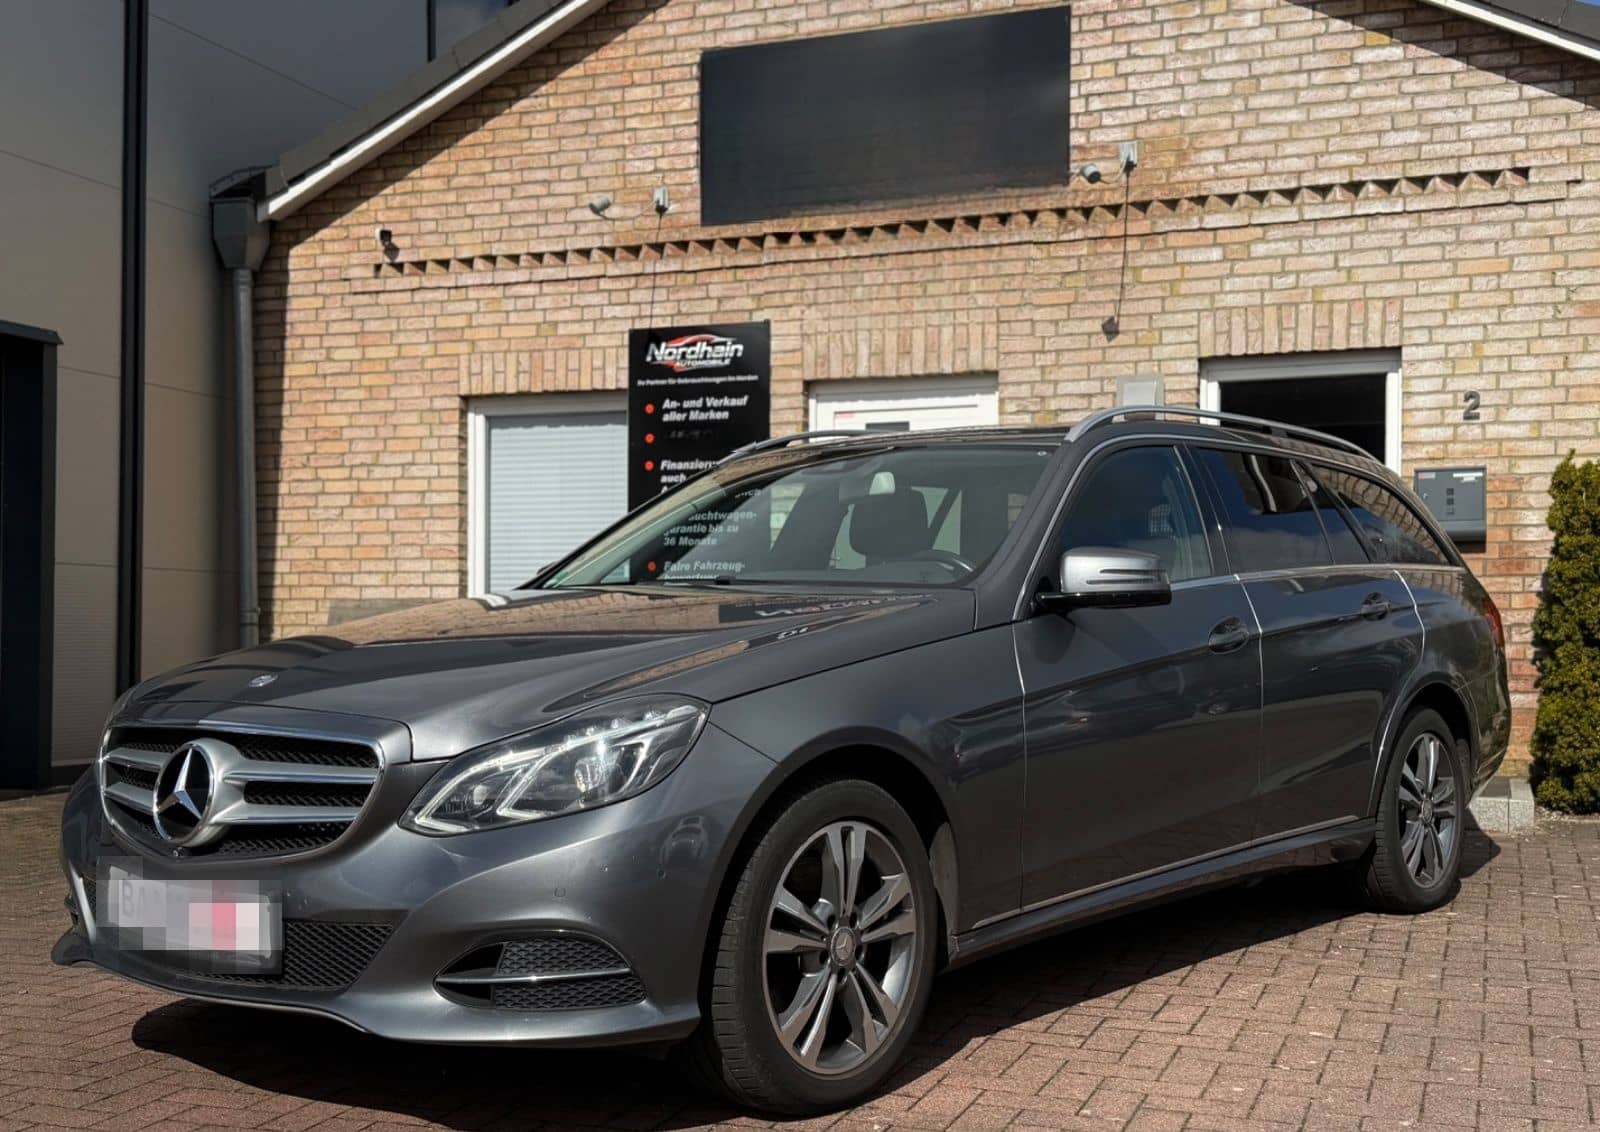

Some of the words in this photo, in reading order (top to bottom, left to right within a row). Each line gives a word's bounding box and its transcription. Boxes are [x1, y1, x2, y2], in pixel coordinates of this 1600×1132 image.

[646, 341, 744, 362] Nordhain
[662, 398, 681, 410] An-
[682, 397, 703, 409] und
[705, 394, 749, 407] Verkauf
[1463, 391, 1480, 420] 2
[662, 411, 687, 422] aller
[689, 410, 729, 421] Marken
[660, 472, 686, 483] auch
[726, 525, 739, 533] zu
[663, 537, 677, 546] 36
[664, 561, 691, 571] Faire
[693, 560, 745, 573] Fahrzeug-
